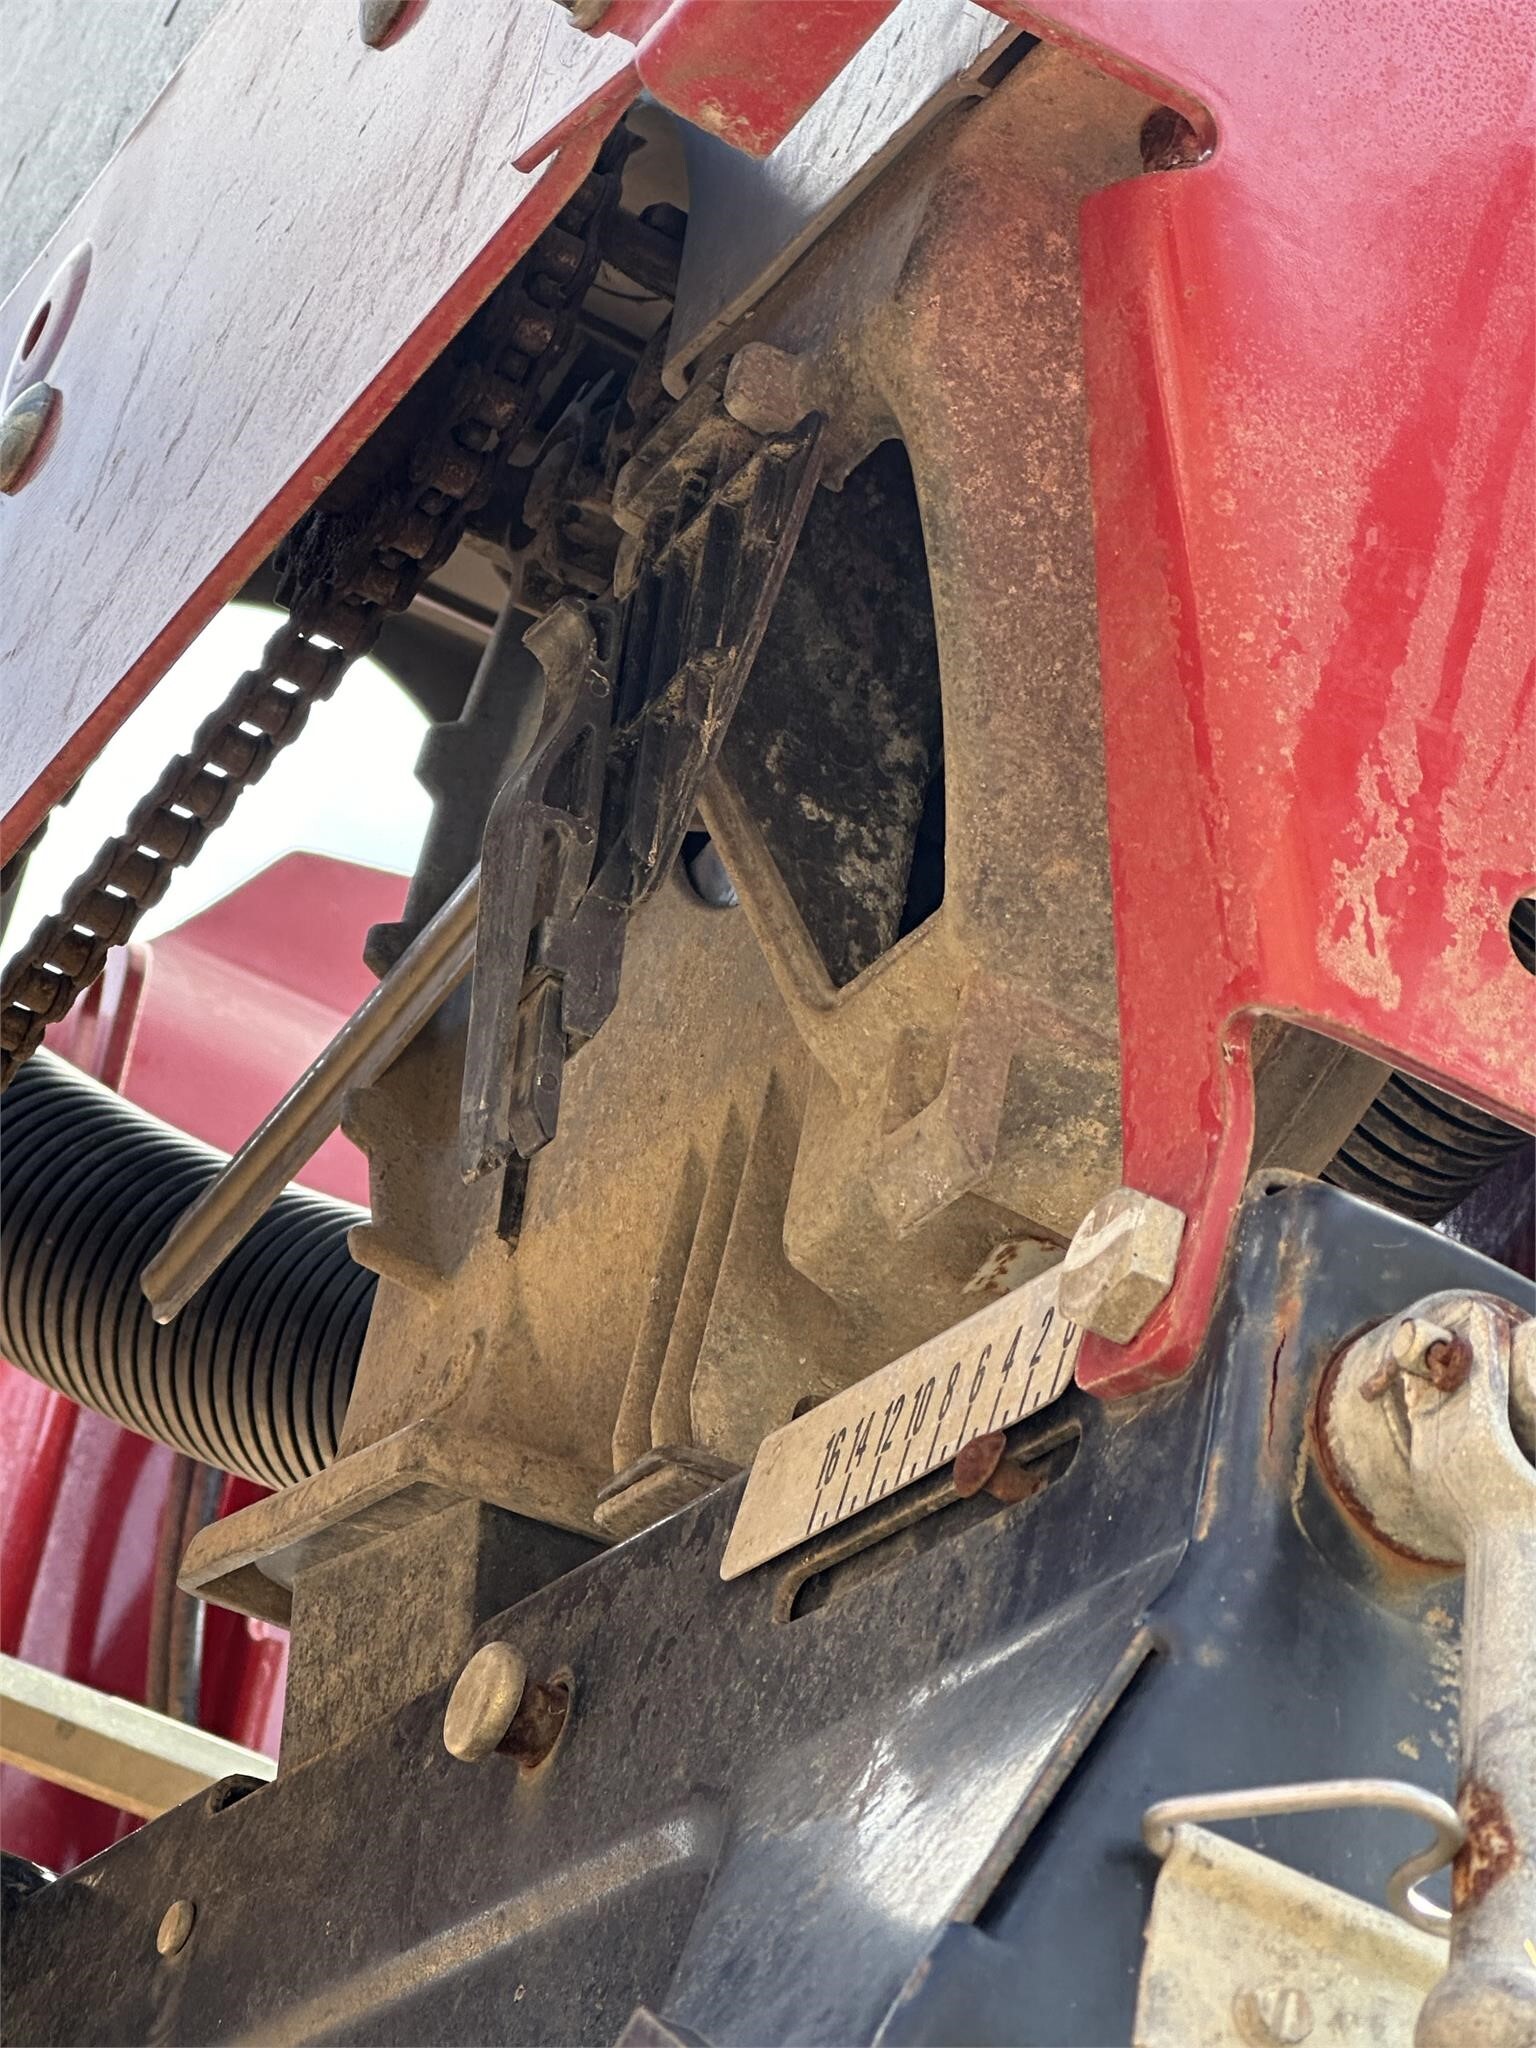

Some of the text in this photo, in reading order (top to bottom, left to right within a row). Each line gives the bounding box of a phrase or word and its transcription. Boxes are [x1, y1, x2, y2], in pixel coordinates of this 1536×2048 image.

[816, 1427, 846, 1490] 16
[845, 1411, 875, 1473] 14
[875, 1394, 905, 1457] 12
[904, 1376, 936, 1440] 10
[938, 1361, 961, 1421] 8
[968, 1343, 992, 1404] 6
[1001, 1325, 1023, 1383] 4
[1029, 1305, 1055, 1368] 2
